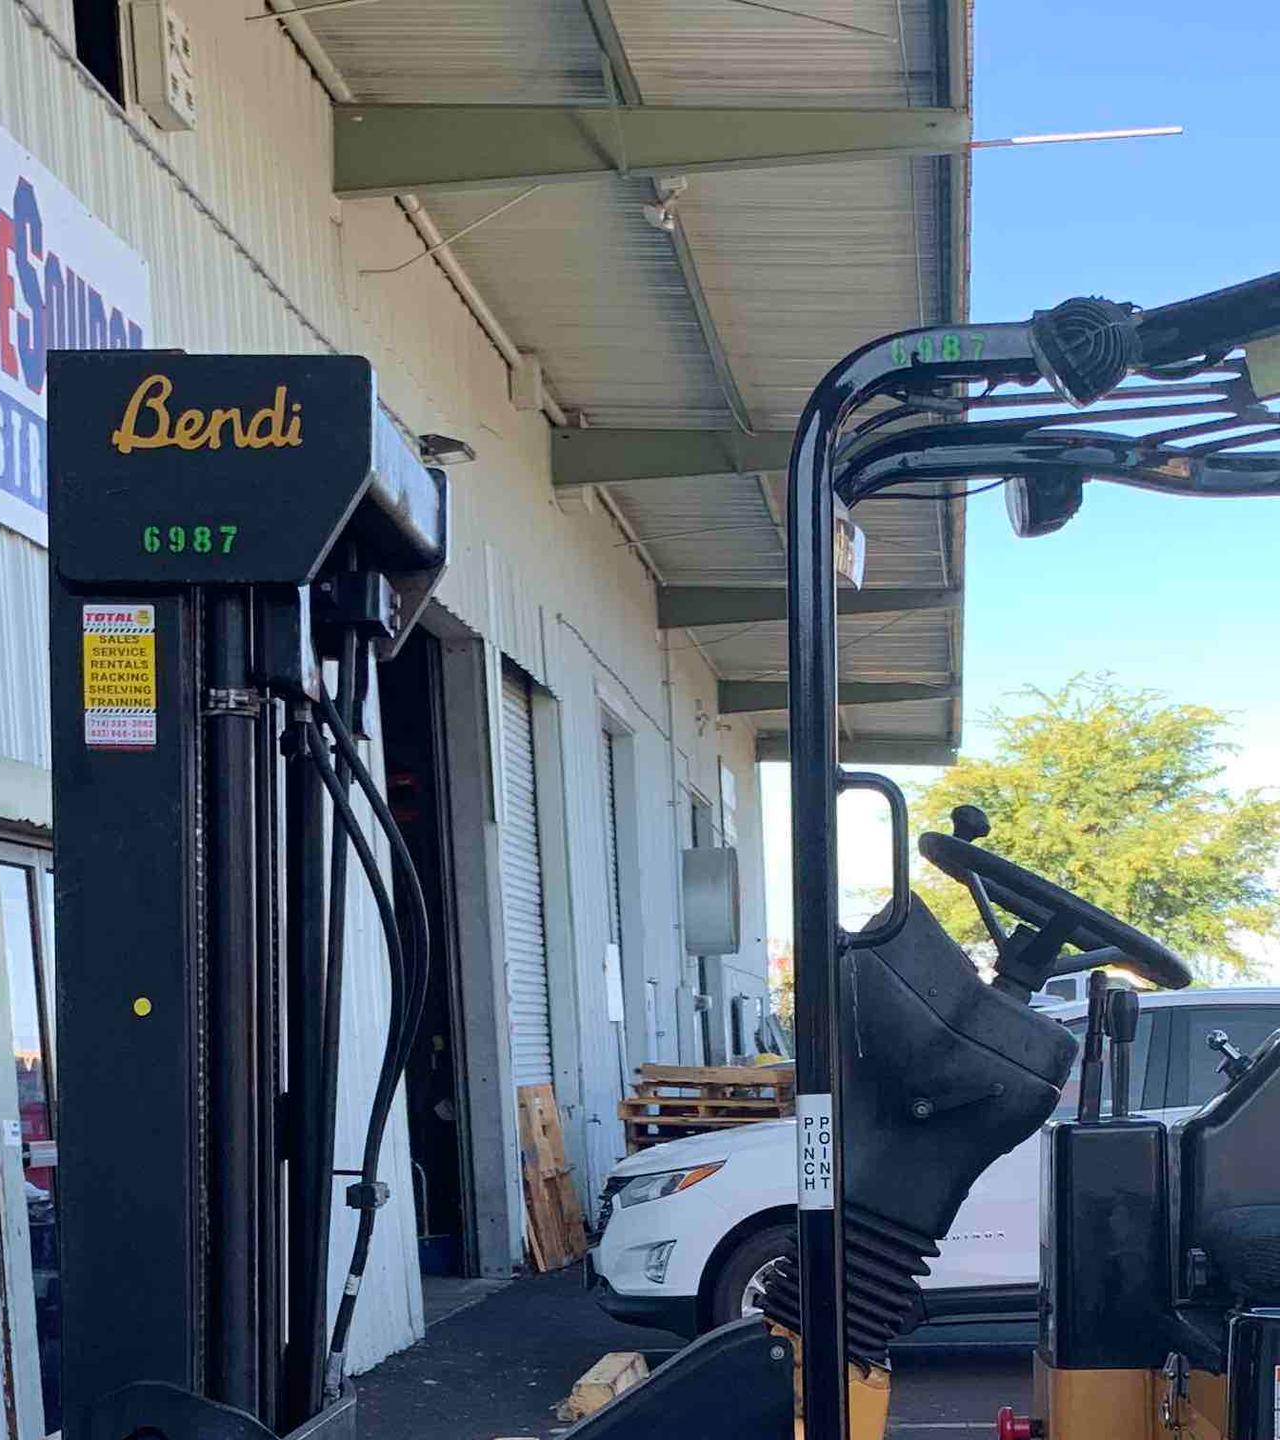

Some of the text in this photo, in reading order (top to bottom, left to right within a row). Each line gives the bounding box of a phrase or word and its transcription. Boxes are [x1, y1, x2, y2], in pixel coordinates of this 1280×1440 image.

[112, 374, 303, 454] Bendi
[144, 526, 238, 553] 6987
[85, 612, 134, 622] TOTAL
[99, 635, 140, 644] SALES
[92, 648, 147, 657] SERVICE
[90, 660, 149, 669] RENTALS
[91, 673, 149, 682] RACKING
[88, 685, 152, 695] SHELVING
[89, 698, 152, 707] TRAINING
[803, 1117, 816, 1190] PINCH
[819, 1116, 831, 1190] POINT
